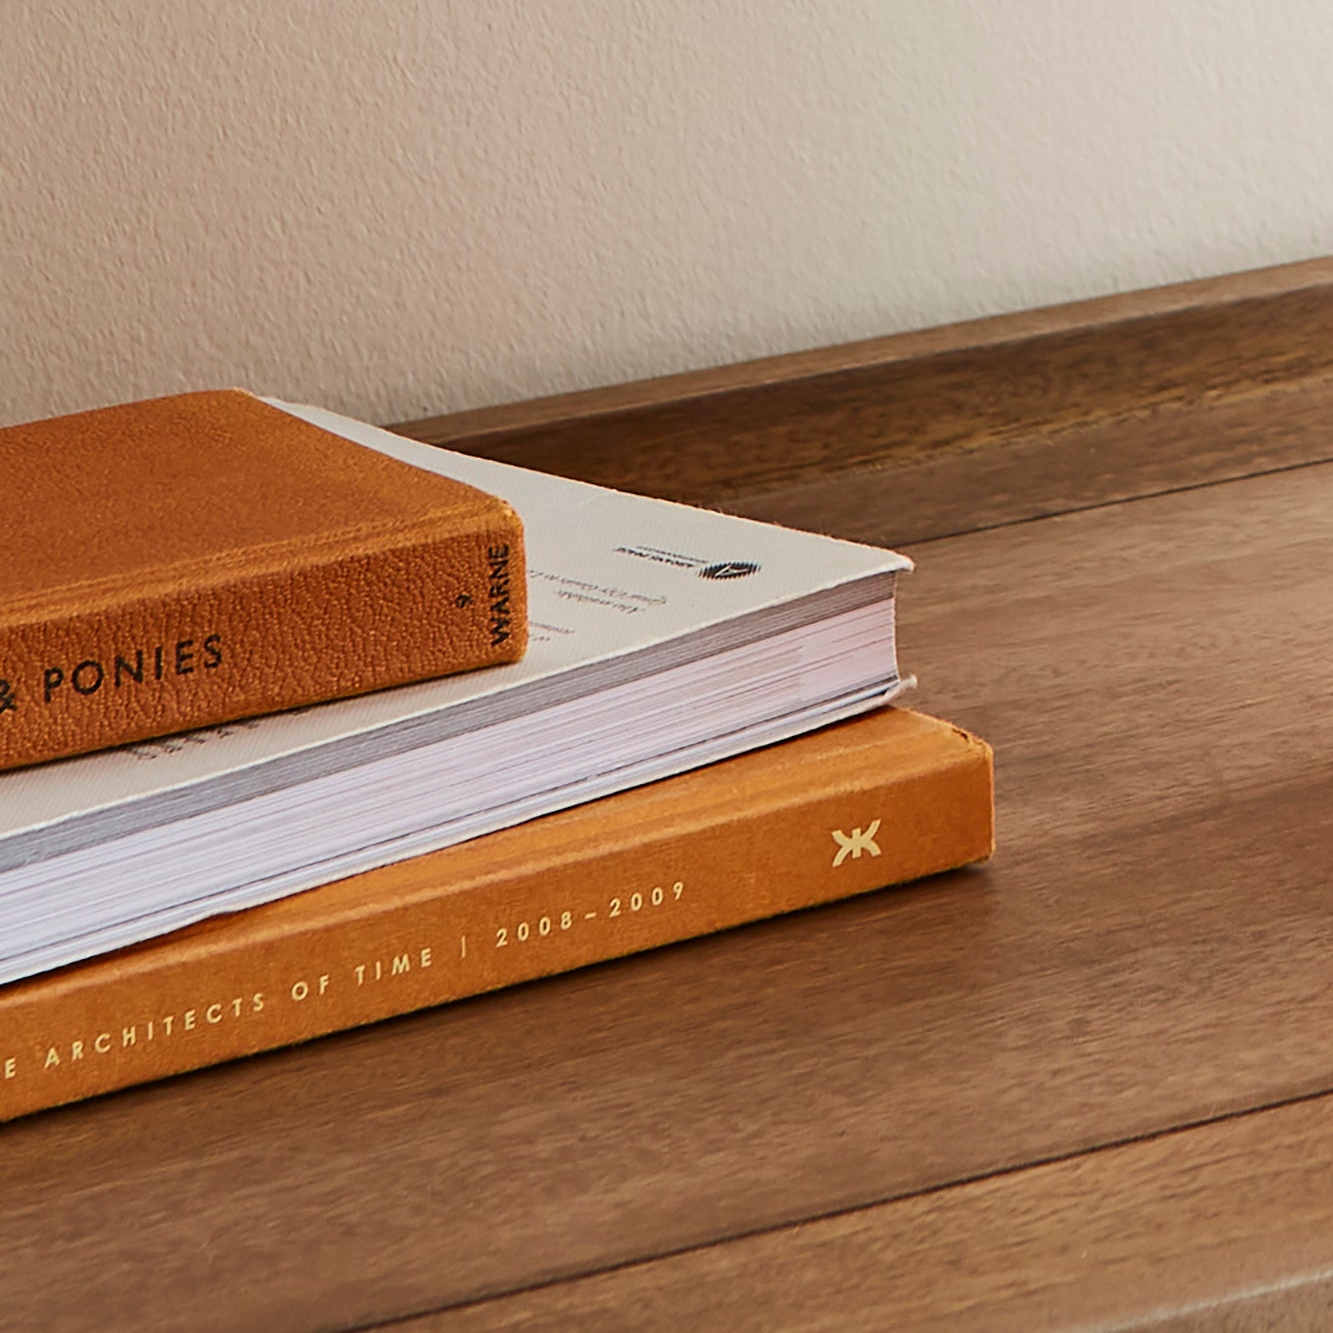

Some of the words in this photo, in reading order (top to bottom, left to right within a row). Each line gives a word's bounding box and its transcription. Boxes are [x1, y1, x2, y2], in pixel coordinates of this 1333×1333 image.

[487, 543, 510, 647] WARNE
[43, 633, 222, 703] PONIES
[44, 992, 265, 1069] ARCHITECTS
[291, 974, 330, 1002] OF
[355, 947, 433, 986] TIME
